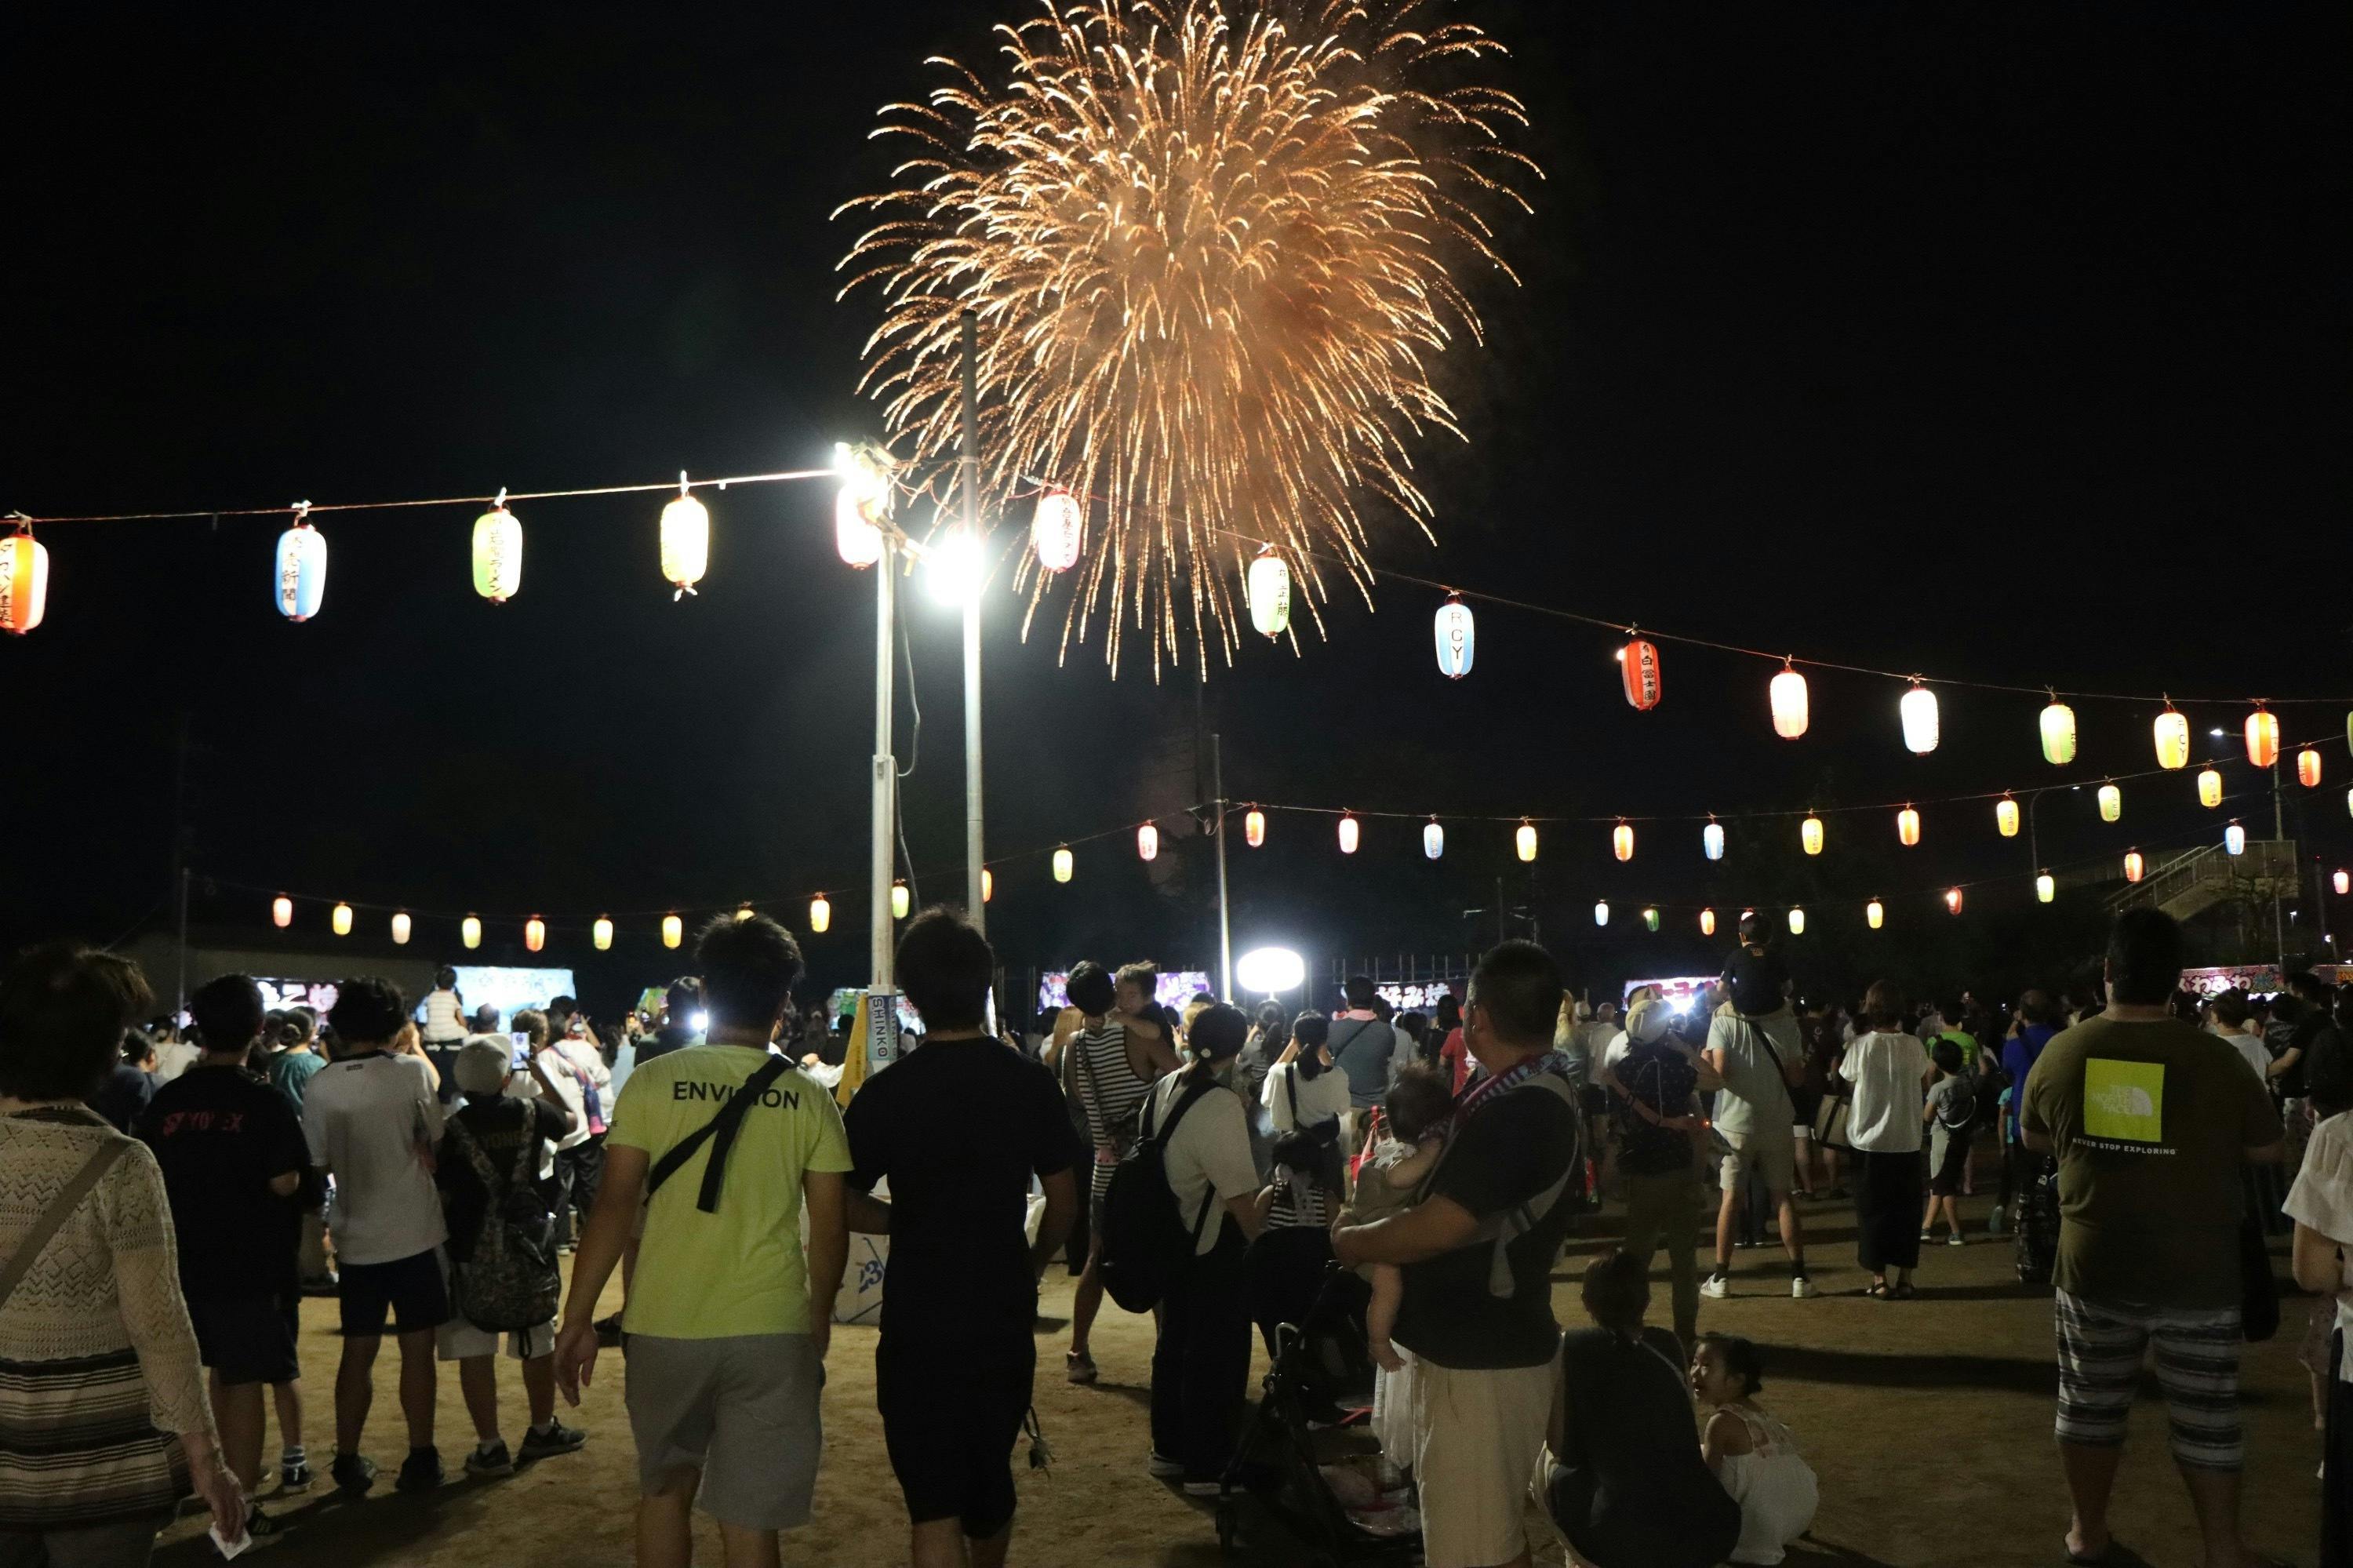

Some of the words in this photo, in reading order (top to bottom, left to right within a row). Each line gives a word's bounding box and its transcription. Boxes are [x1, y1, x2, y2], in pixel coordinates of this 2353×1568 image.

[1451, 612, 1463, 660] RCY
[872, 996, 889, 1057] SHINKO
[674, 1081, 799, 1110] ENVIION
[2072, 1137, 2096, 1148] NEVER
[2099, 1142, 2121, 1151] STOP
[2123, 1145, 2176, 1155] EXPLORING
